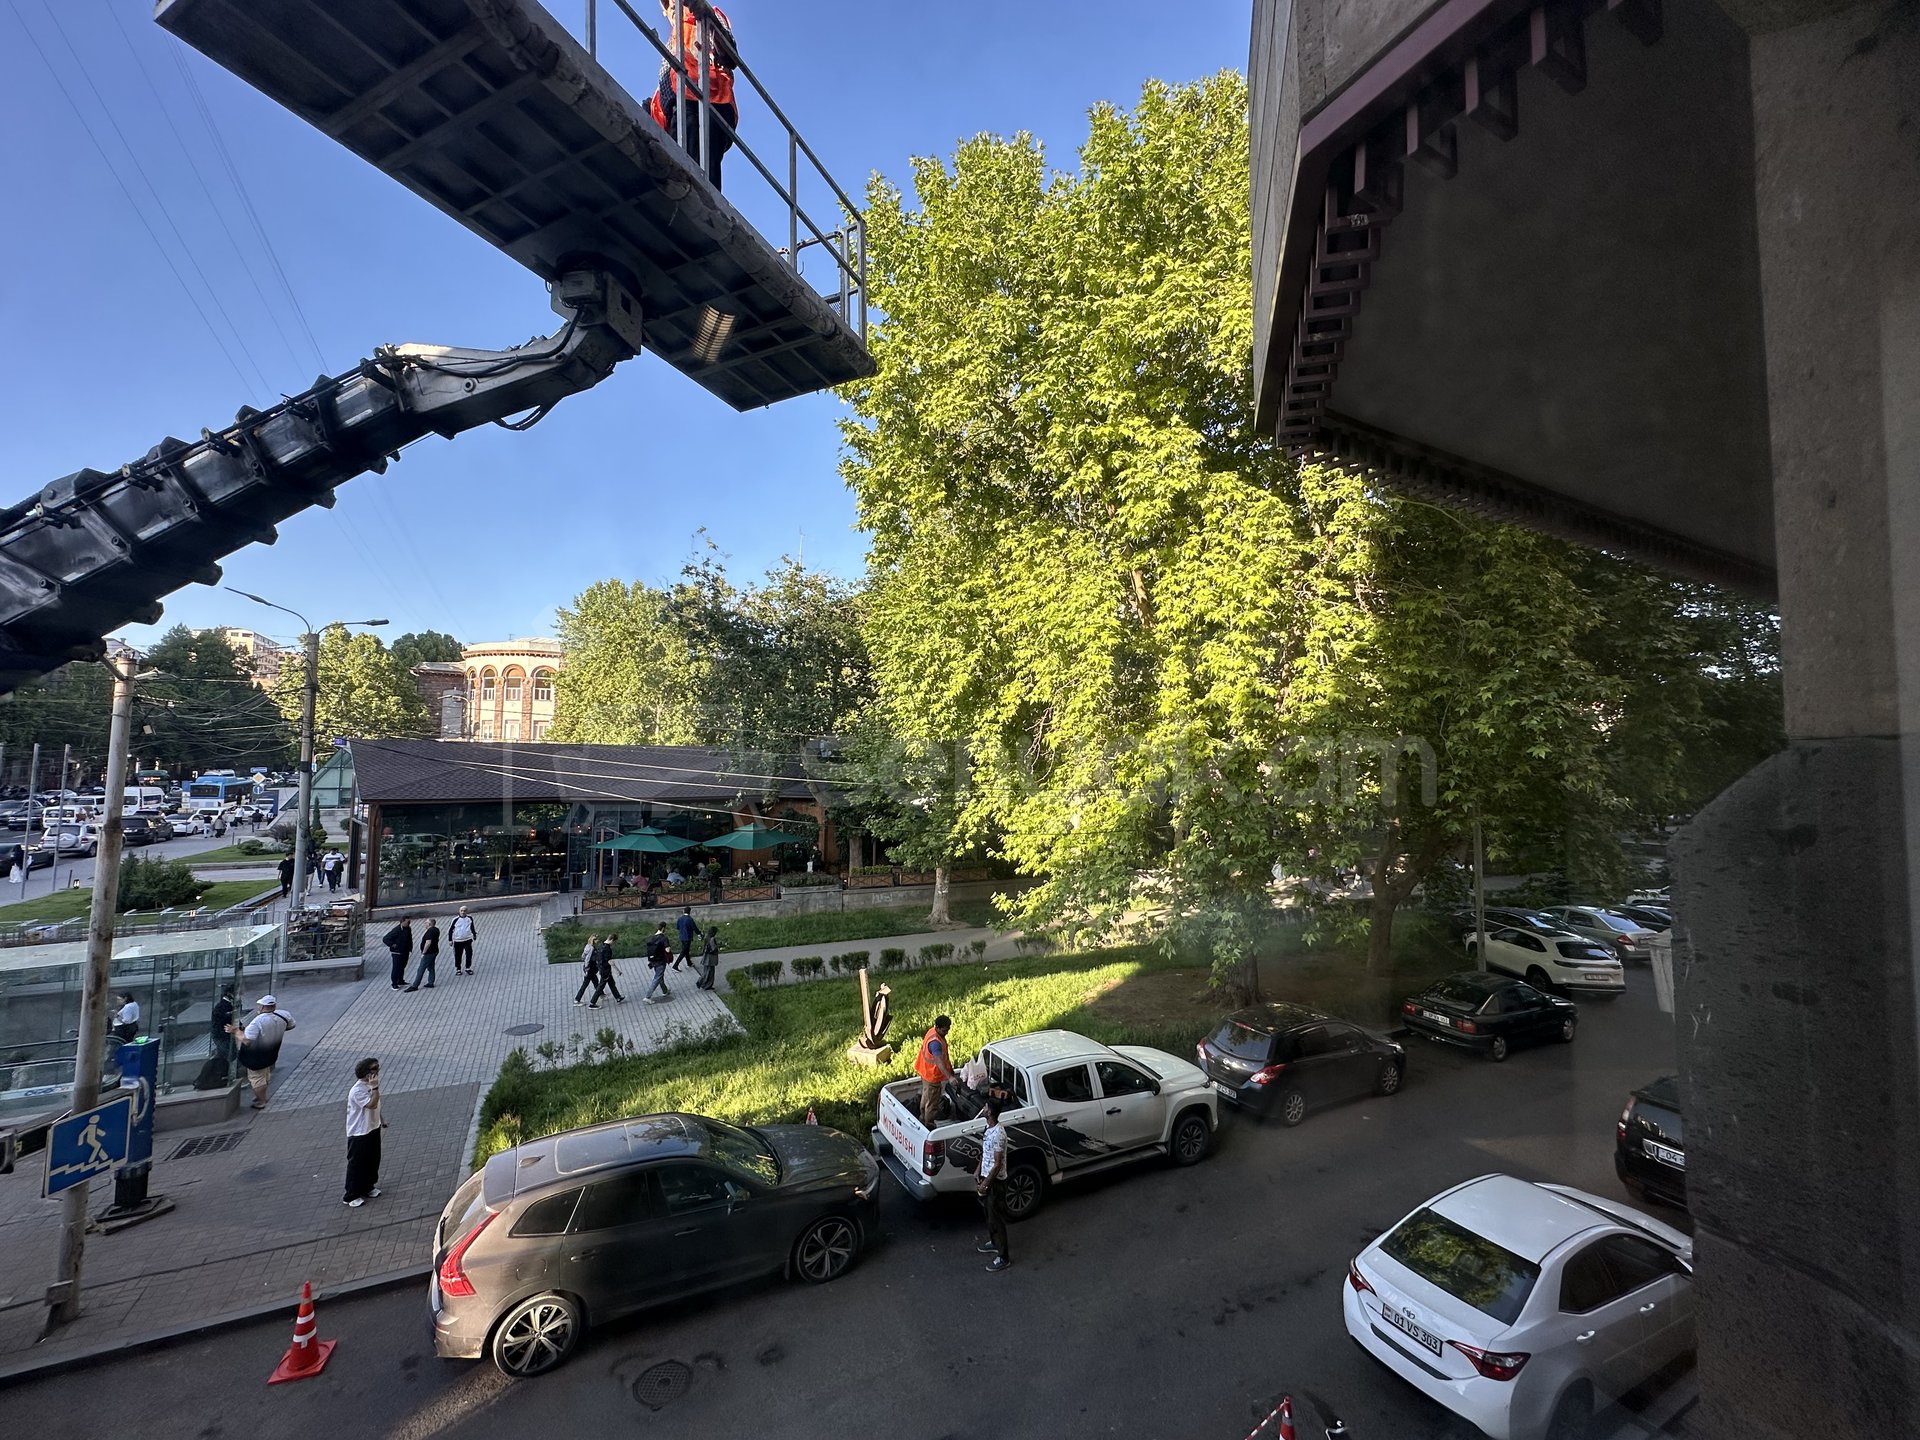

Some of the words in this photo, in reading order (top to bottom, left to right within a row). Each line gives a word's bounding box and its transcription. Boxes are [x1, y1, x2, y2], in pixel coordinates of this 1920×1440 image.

[883, 1114, 916, 1158] MITSUBISHI
[950, 1137, 981, 1161] L20
[1665, 1152, 1677, 1162] 04
[1394, 1313, 1404, 1328] 01
[1407, 1321, 1420, 1337] VS
[1421, 1330, 1438, 1350] 303
